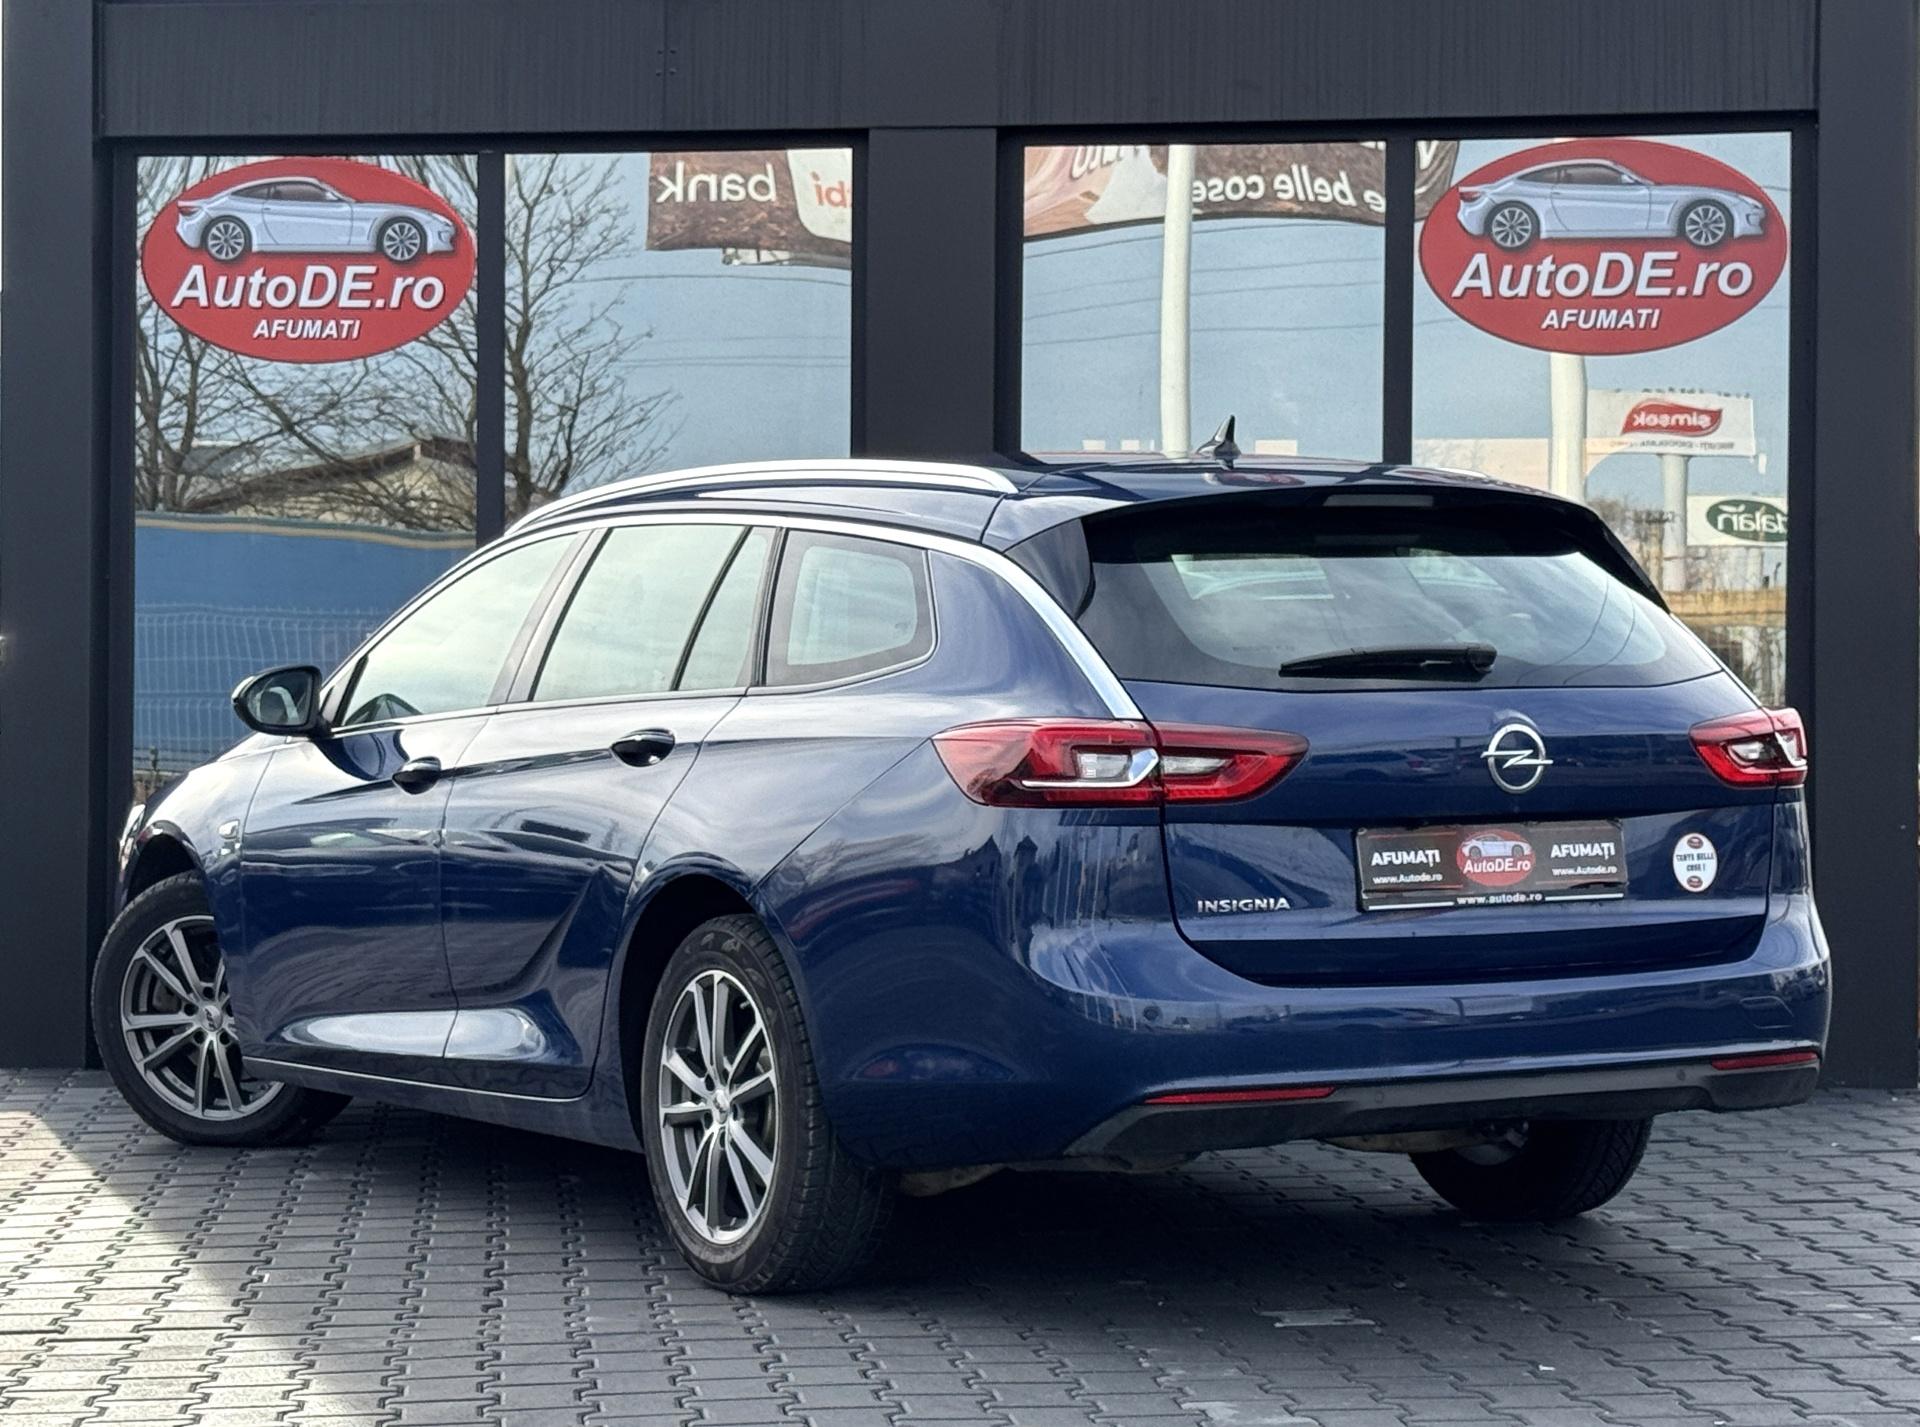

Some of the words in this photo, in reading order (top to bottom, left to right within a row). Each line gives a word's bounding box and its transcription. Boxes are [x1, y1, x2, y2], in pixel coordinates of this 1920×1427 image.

[1451, 250, 1754, 299] AutoDE.ro
[171, 264, 445, 310] AutoDE.ro
[252, 318, 361, 340] AFUMATI
[1541, 308, 1661, 330] AFUMATI
[1463, 858, 1532, 874] AutoDE.ro
[1197, 896, 1291, 913] INSIGNIA
[1456, 893, 1543, 905] www.autode.ro
